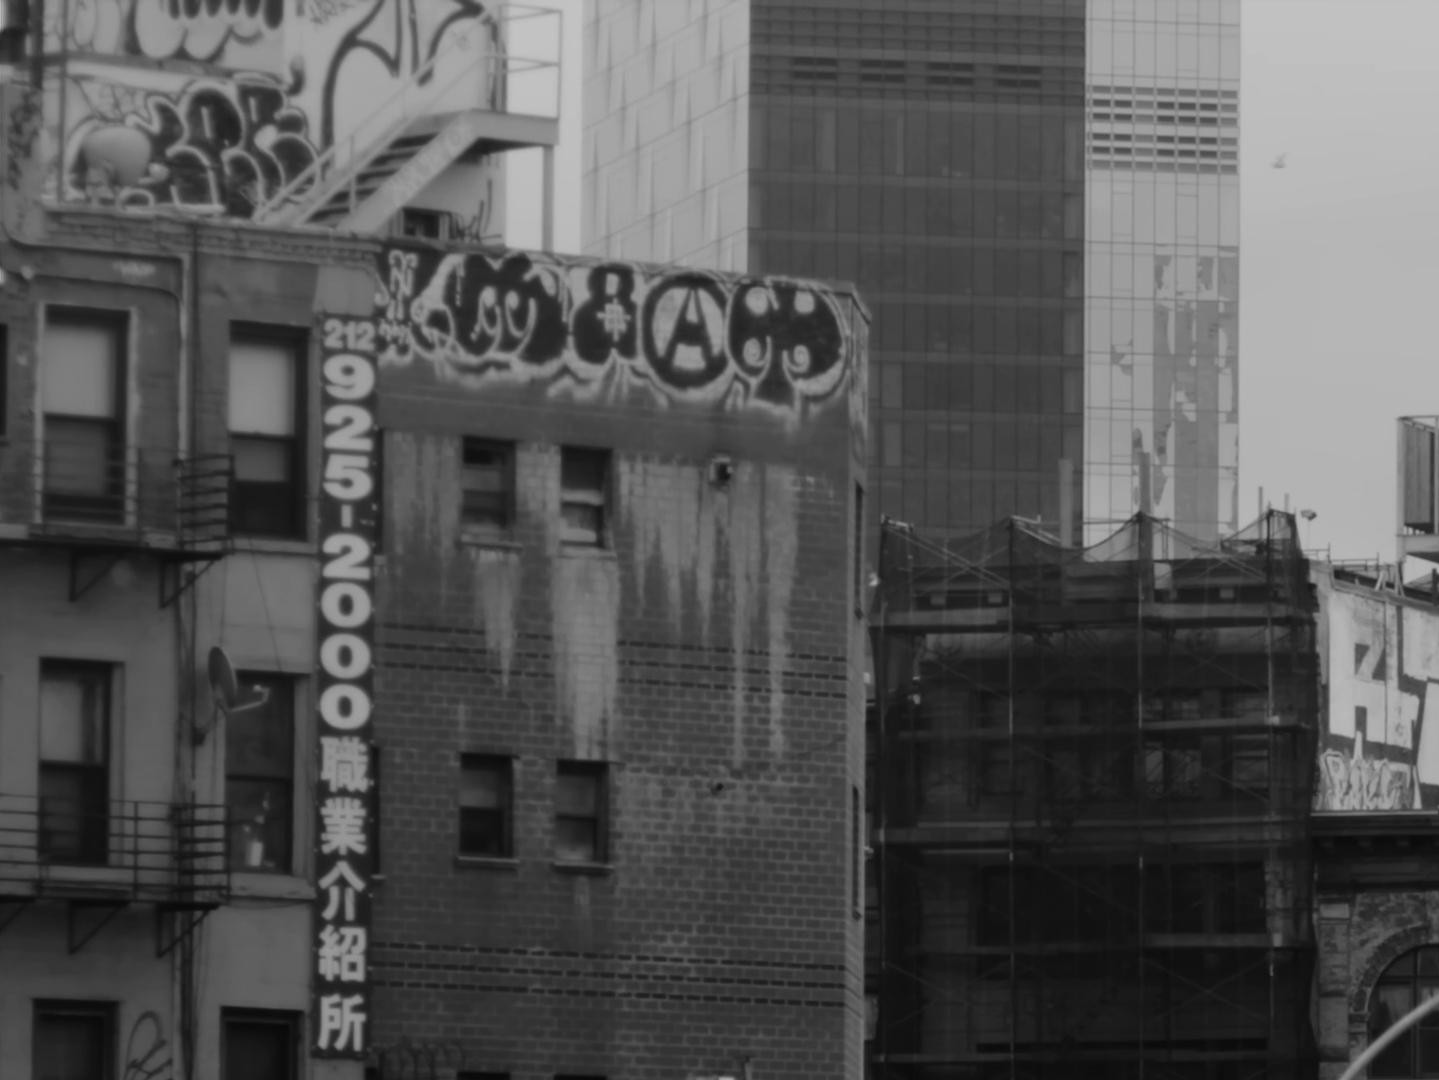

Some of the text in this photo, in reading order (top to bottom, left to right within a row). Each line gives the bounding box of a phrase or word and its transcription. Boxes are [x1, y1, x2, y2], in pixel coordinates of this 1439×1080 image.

[323, 320, 376, 351] 212
[316, 734, 371, 1054] 職業介紹所
